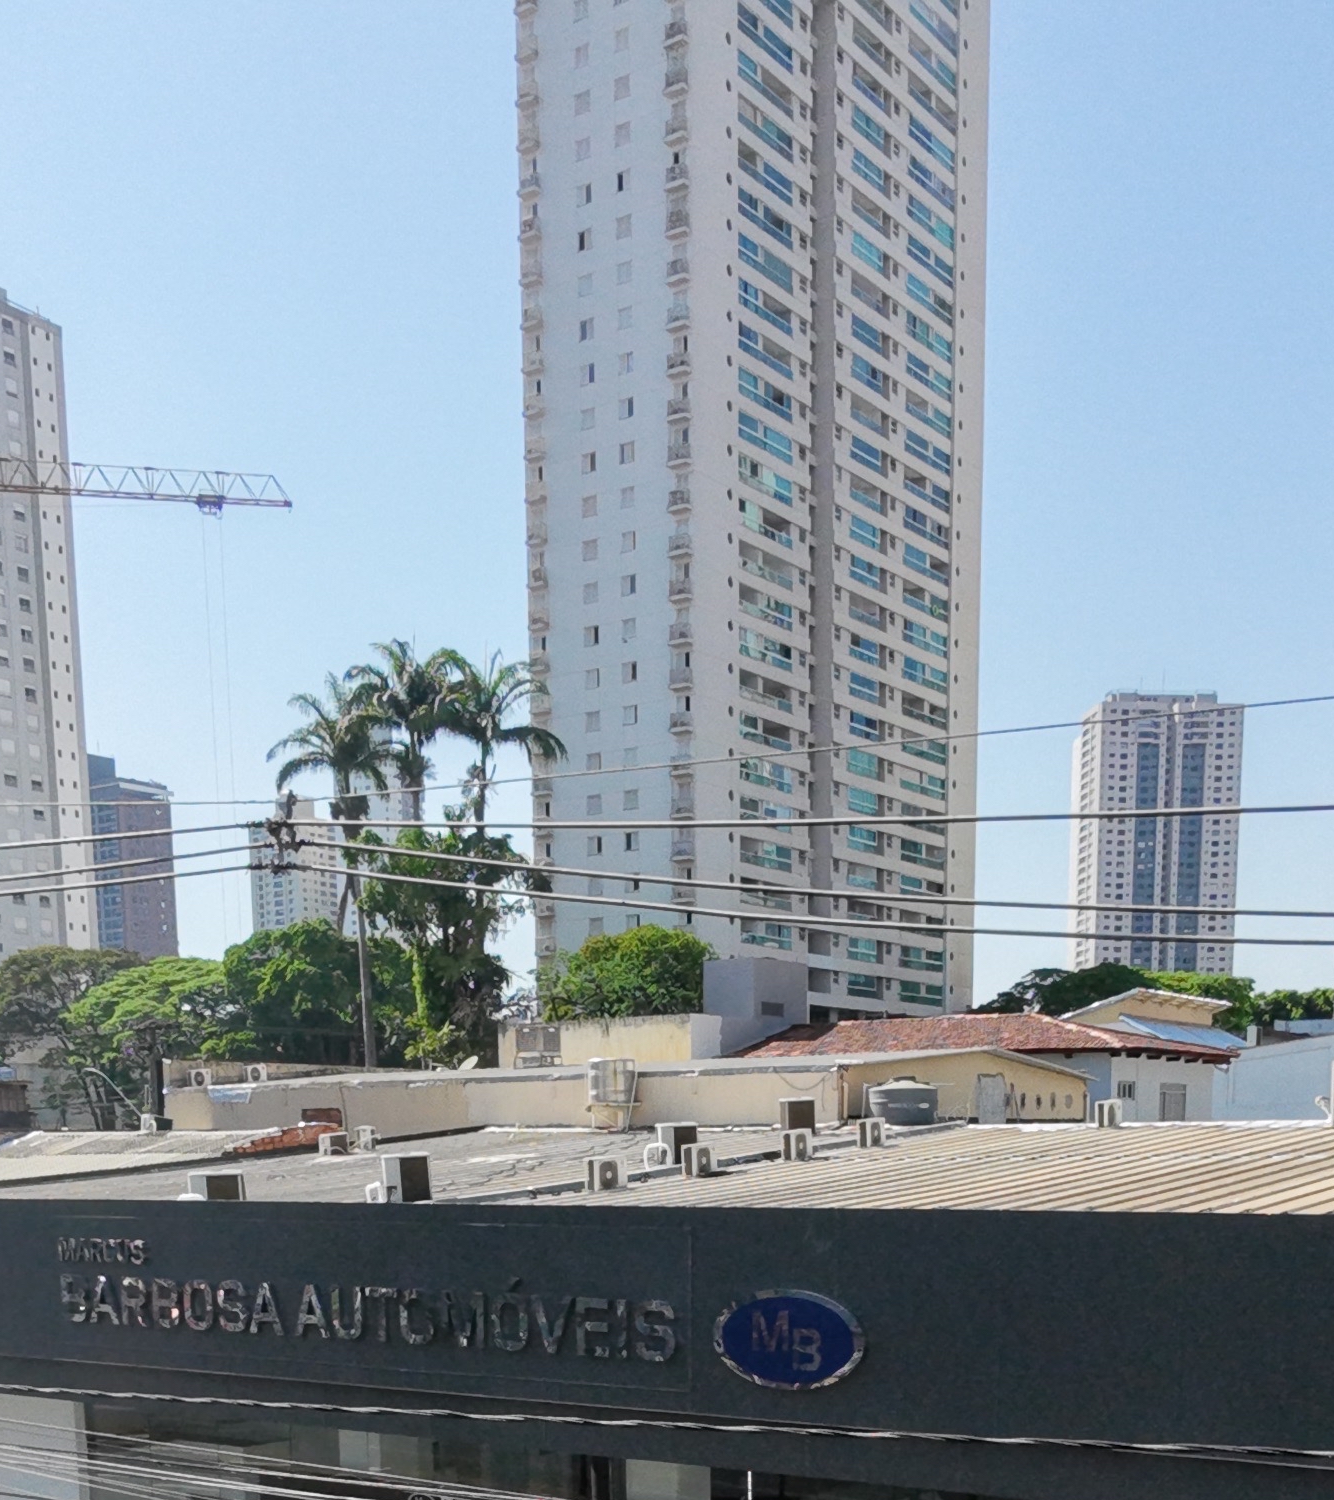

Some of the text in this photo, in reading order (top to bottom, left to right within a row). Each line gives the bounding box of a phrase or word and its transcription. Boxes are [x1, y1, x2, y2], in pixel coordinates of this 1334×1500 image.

[59, 1272, 678, 1363] BARBOSA AUTOMÓVEIS
[751, 1309, 822, 1372] MB
